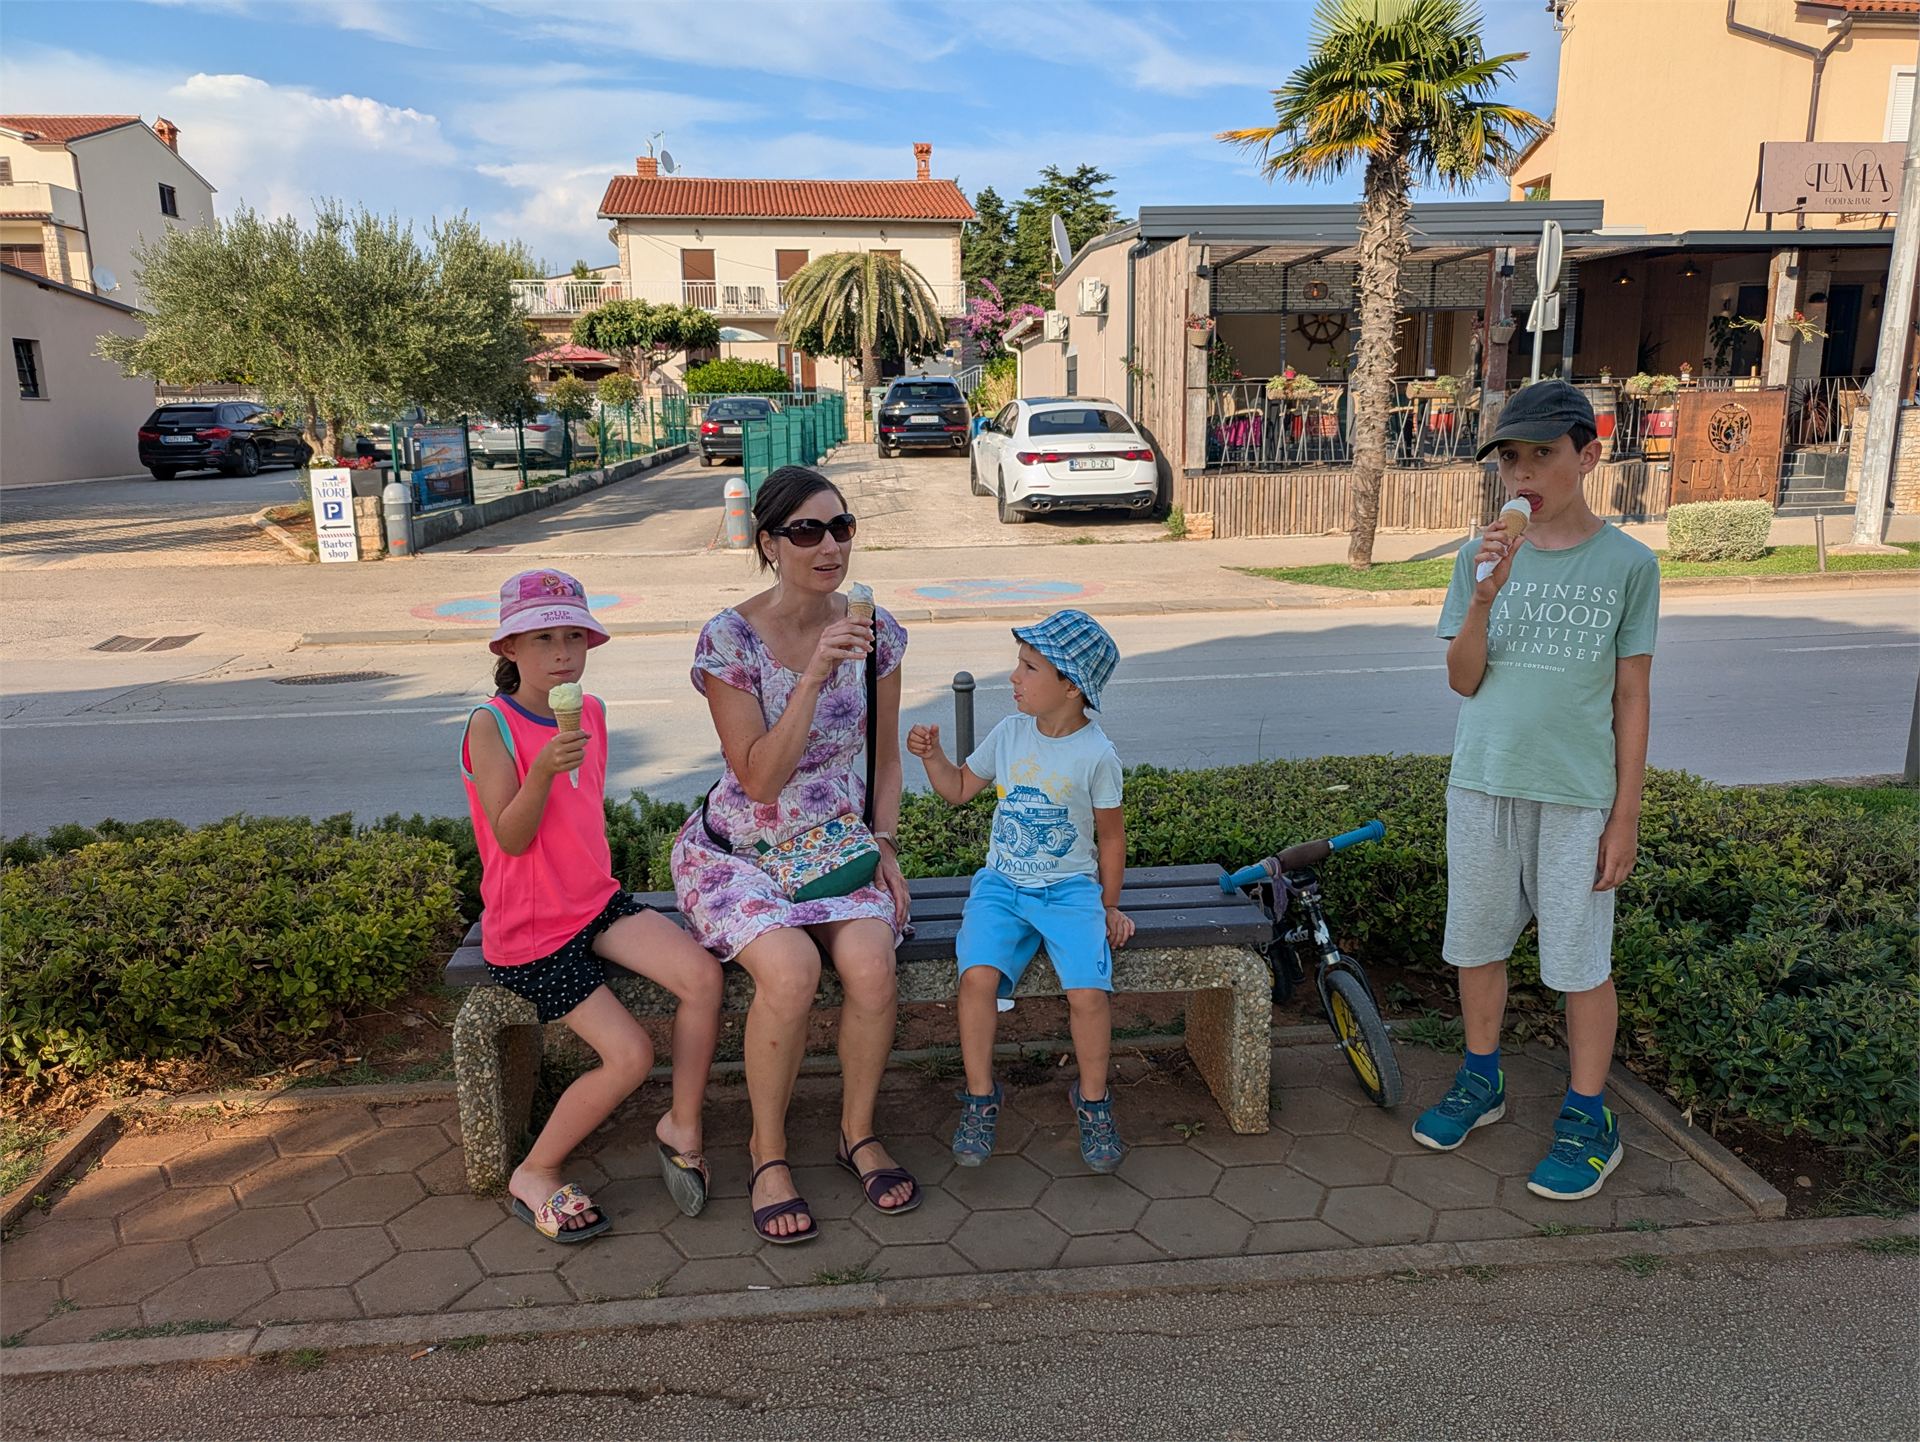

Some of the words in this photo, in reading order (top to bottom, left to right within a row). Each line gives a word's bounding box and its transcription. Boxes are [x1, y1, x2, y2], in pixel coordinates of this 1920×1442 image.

[1805, 149, 1894, 202] LUMA
[1824, 197, 1846, 205] FOOD
[1854, 197, 1871, 205] BAR
[321, 540, 353, 549] Barber
[328, 549, 349, 559] shop
[1498, 581, 1618, 605] PPINESS
[1496, 600, 1510, 620] A
[1520, 601, 1612, 629] MOOD
[1487, 623, 1606, 646] OSITIVITY
[1505, 640, 1601, 663] MINDSET
